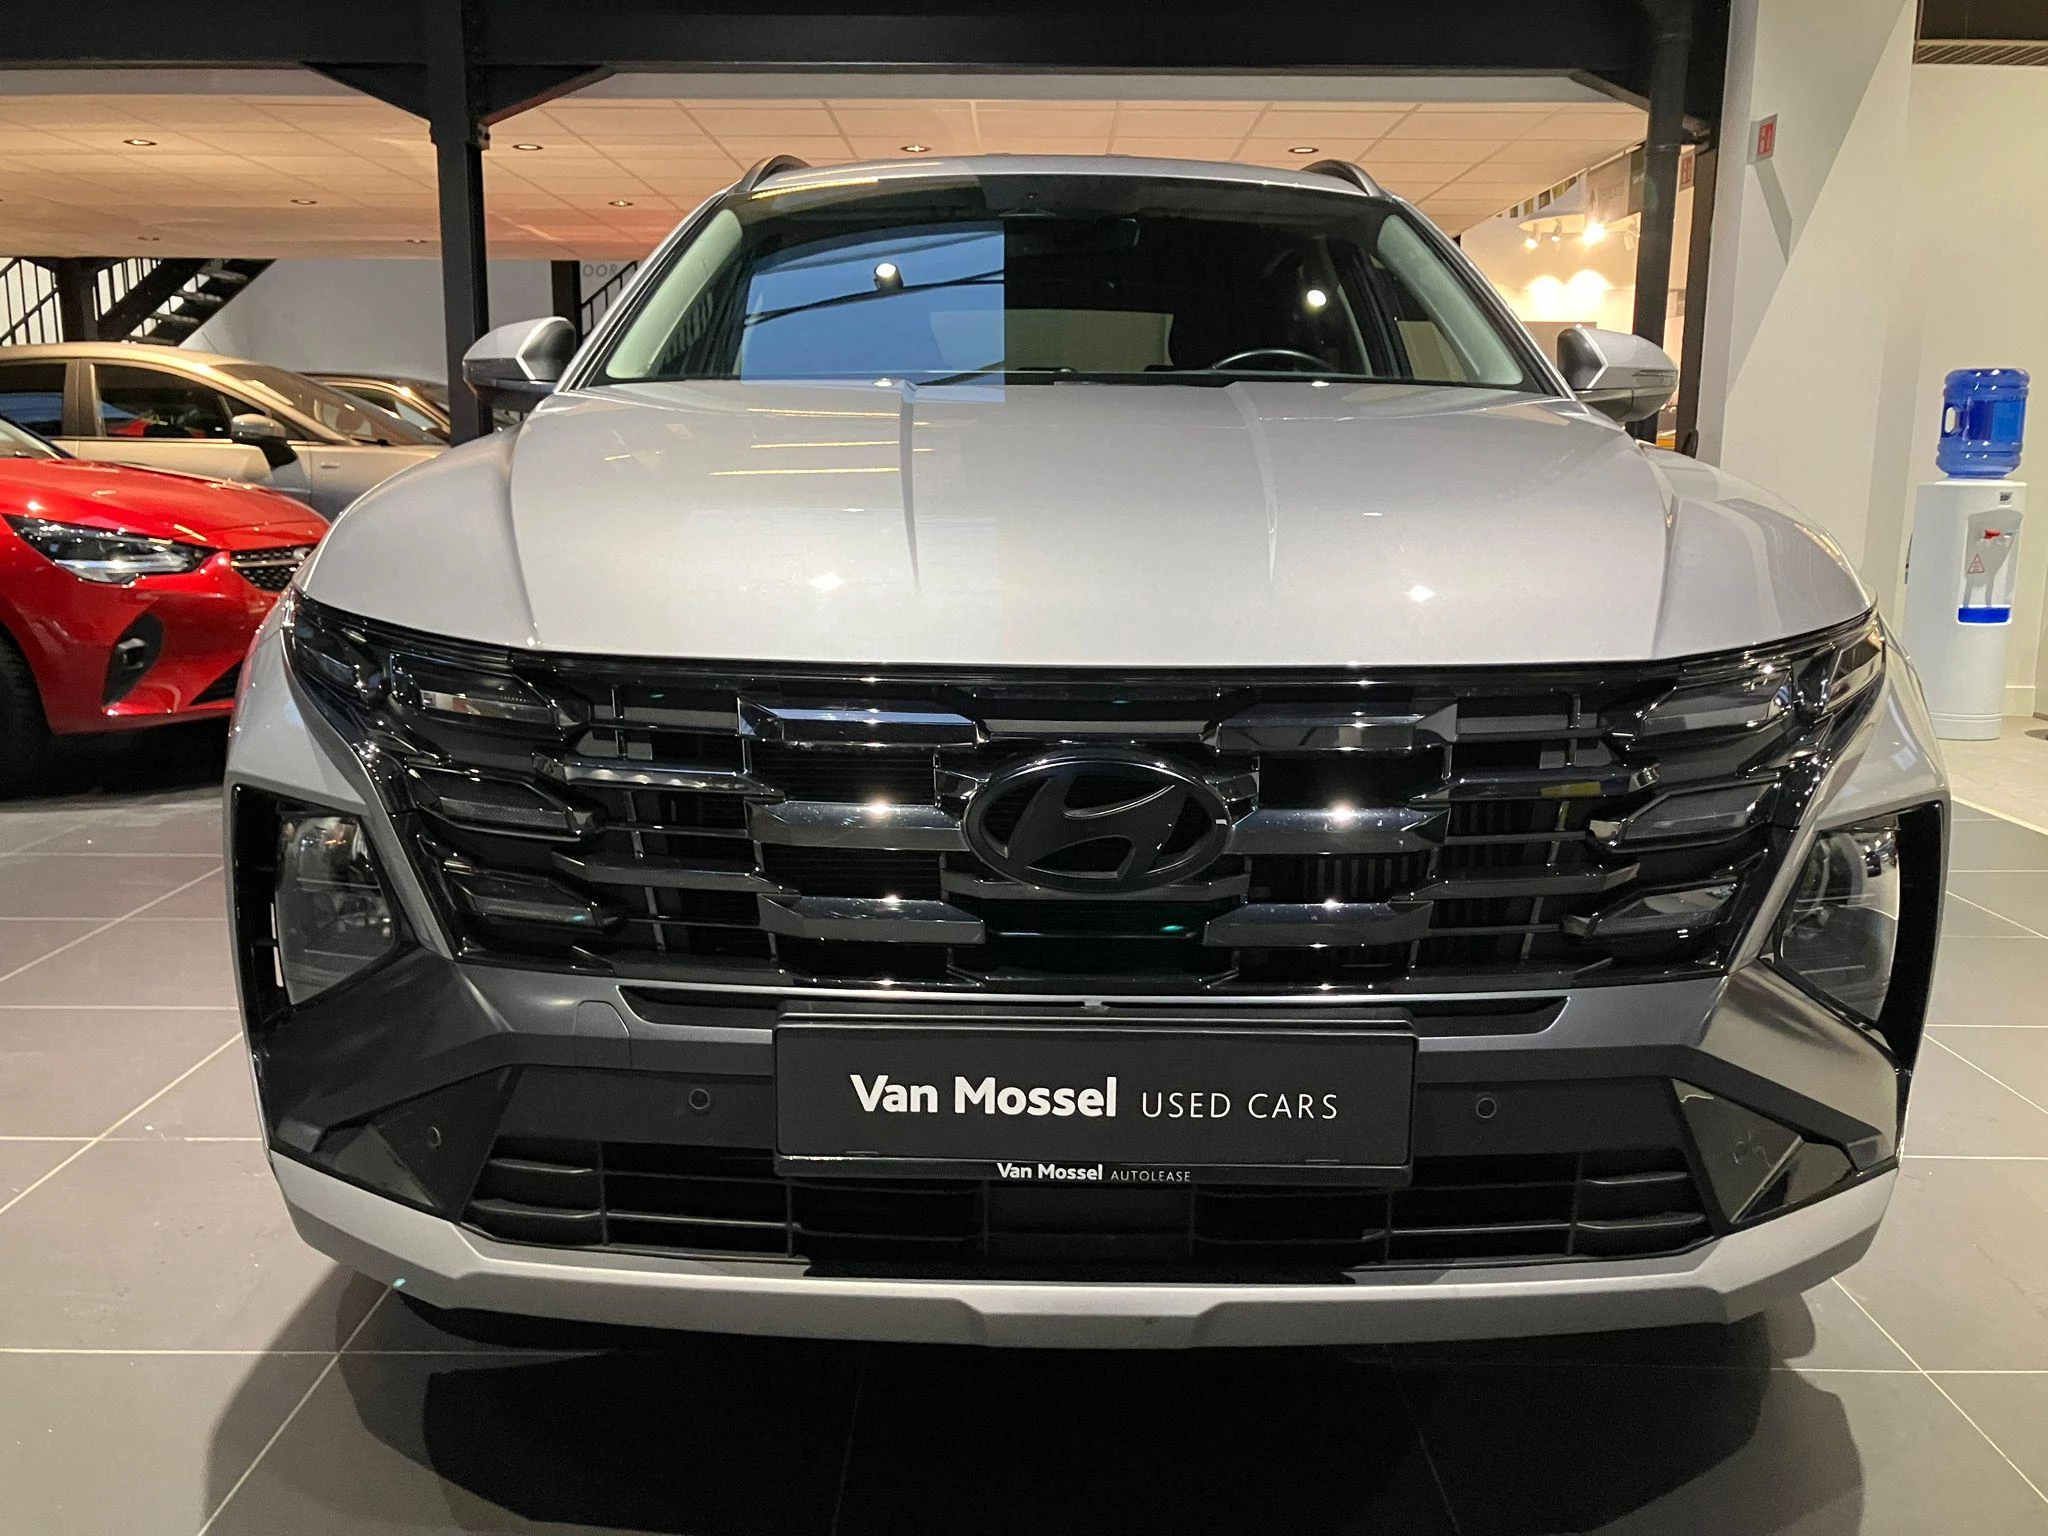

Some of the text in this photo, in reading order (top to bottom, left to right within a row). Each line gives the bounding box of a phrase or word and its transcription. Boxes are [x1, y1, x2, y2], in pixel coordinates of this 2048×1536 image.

[849, 1074, 1338, 1120] Van Mossel USED CARS
[997, 1162, 1191, 1182] Van Mossel AUTOLEASE
